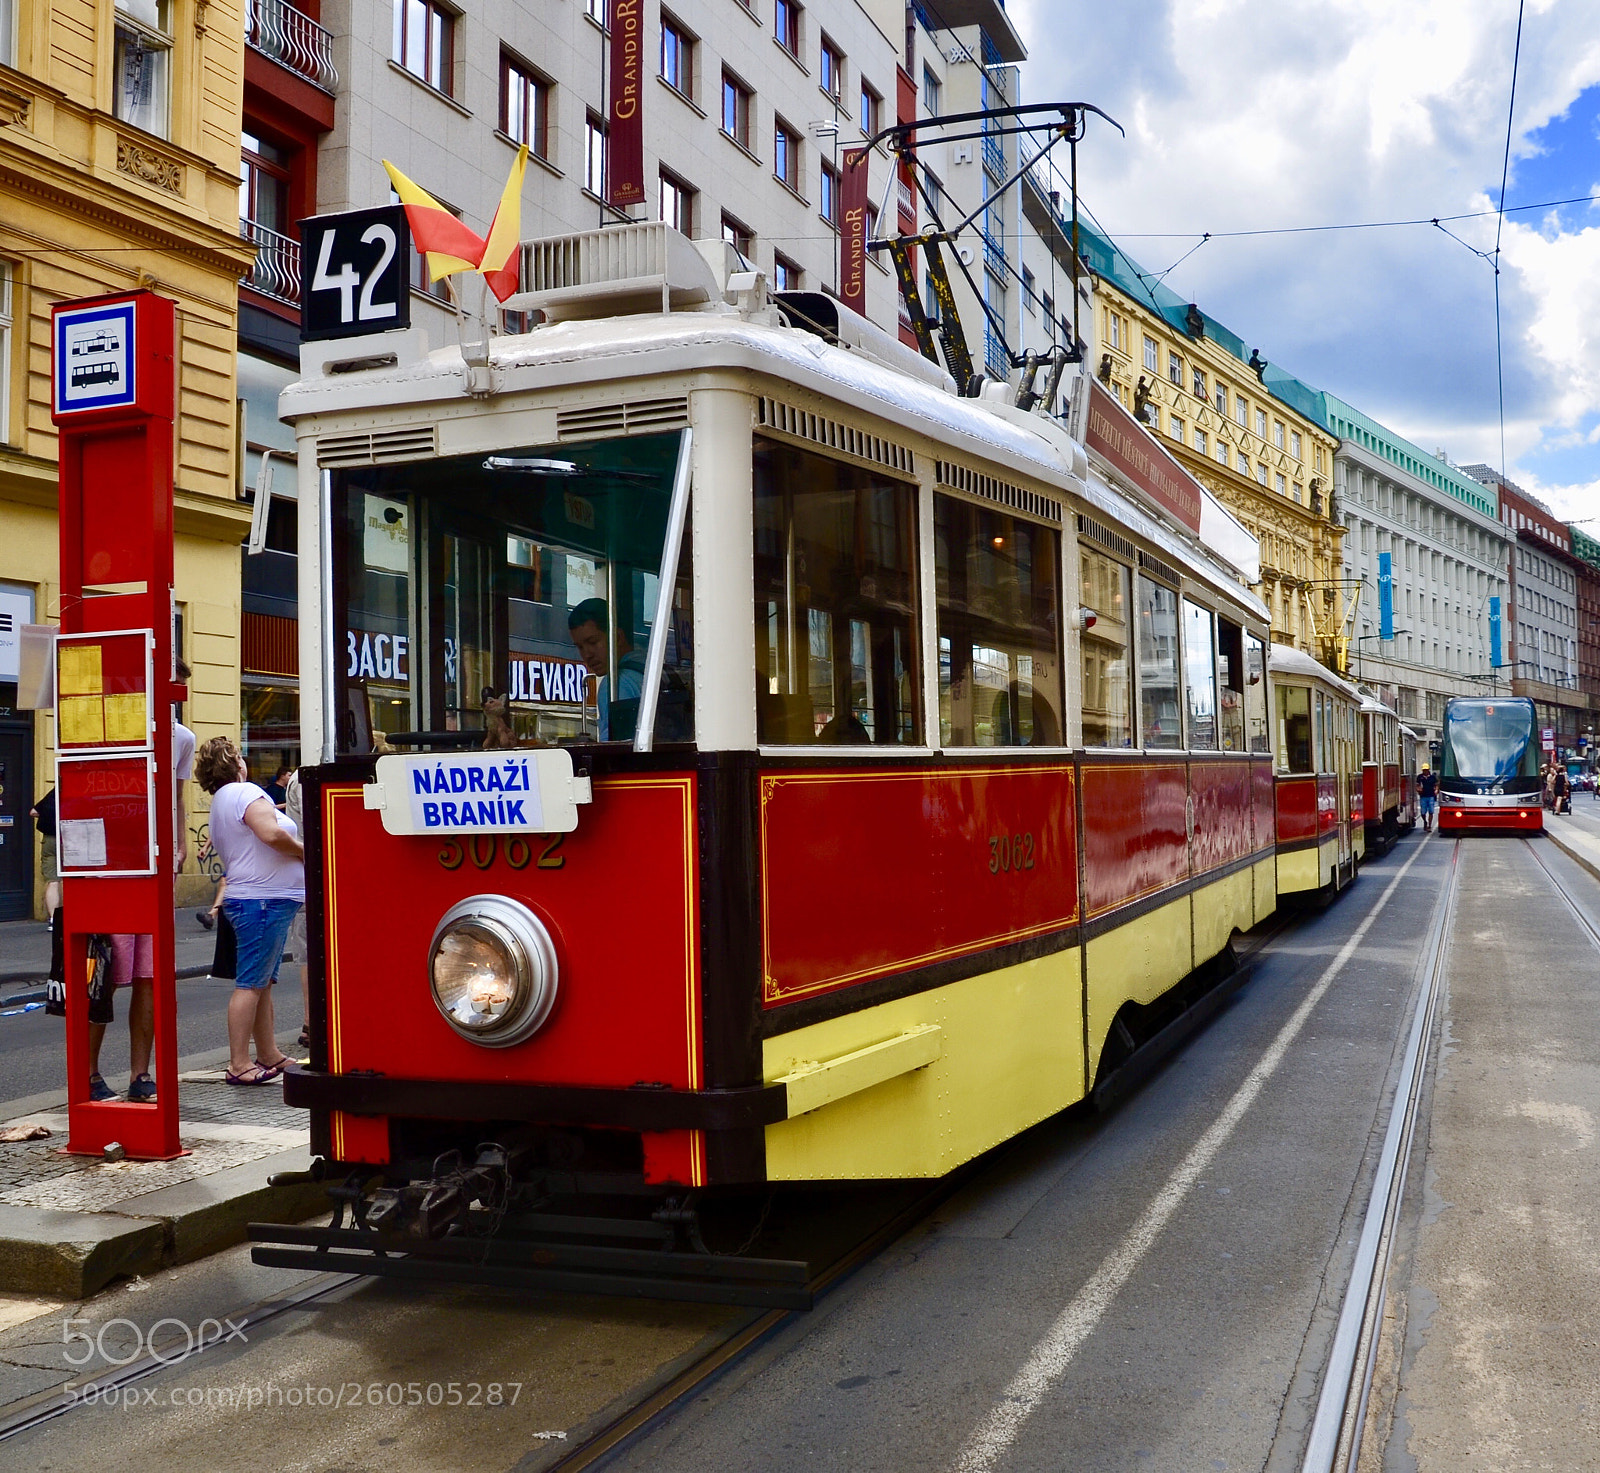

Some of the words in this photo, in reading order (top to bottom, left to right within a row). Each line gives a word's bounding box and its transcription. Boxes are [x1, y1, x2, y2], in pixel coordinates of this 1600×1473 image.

[615, 0, 637, 119] GRANDIOR
[845, 207, 862, 298] GRANDIOR
[312, 224, 397, 323] 42
[413, 759, 530, 795] NÁDRAŽÍ
[424, 795, 527, 827] BRANÍK
[437, 834, 565, 870] 3062
[989, 833, 1035, 874] 3062
